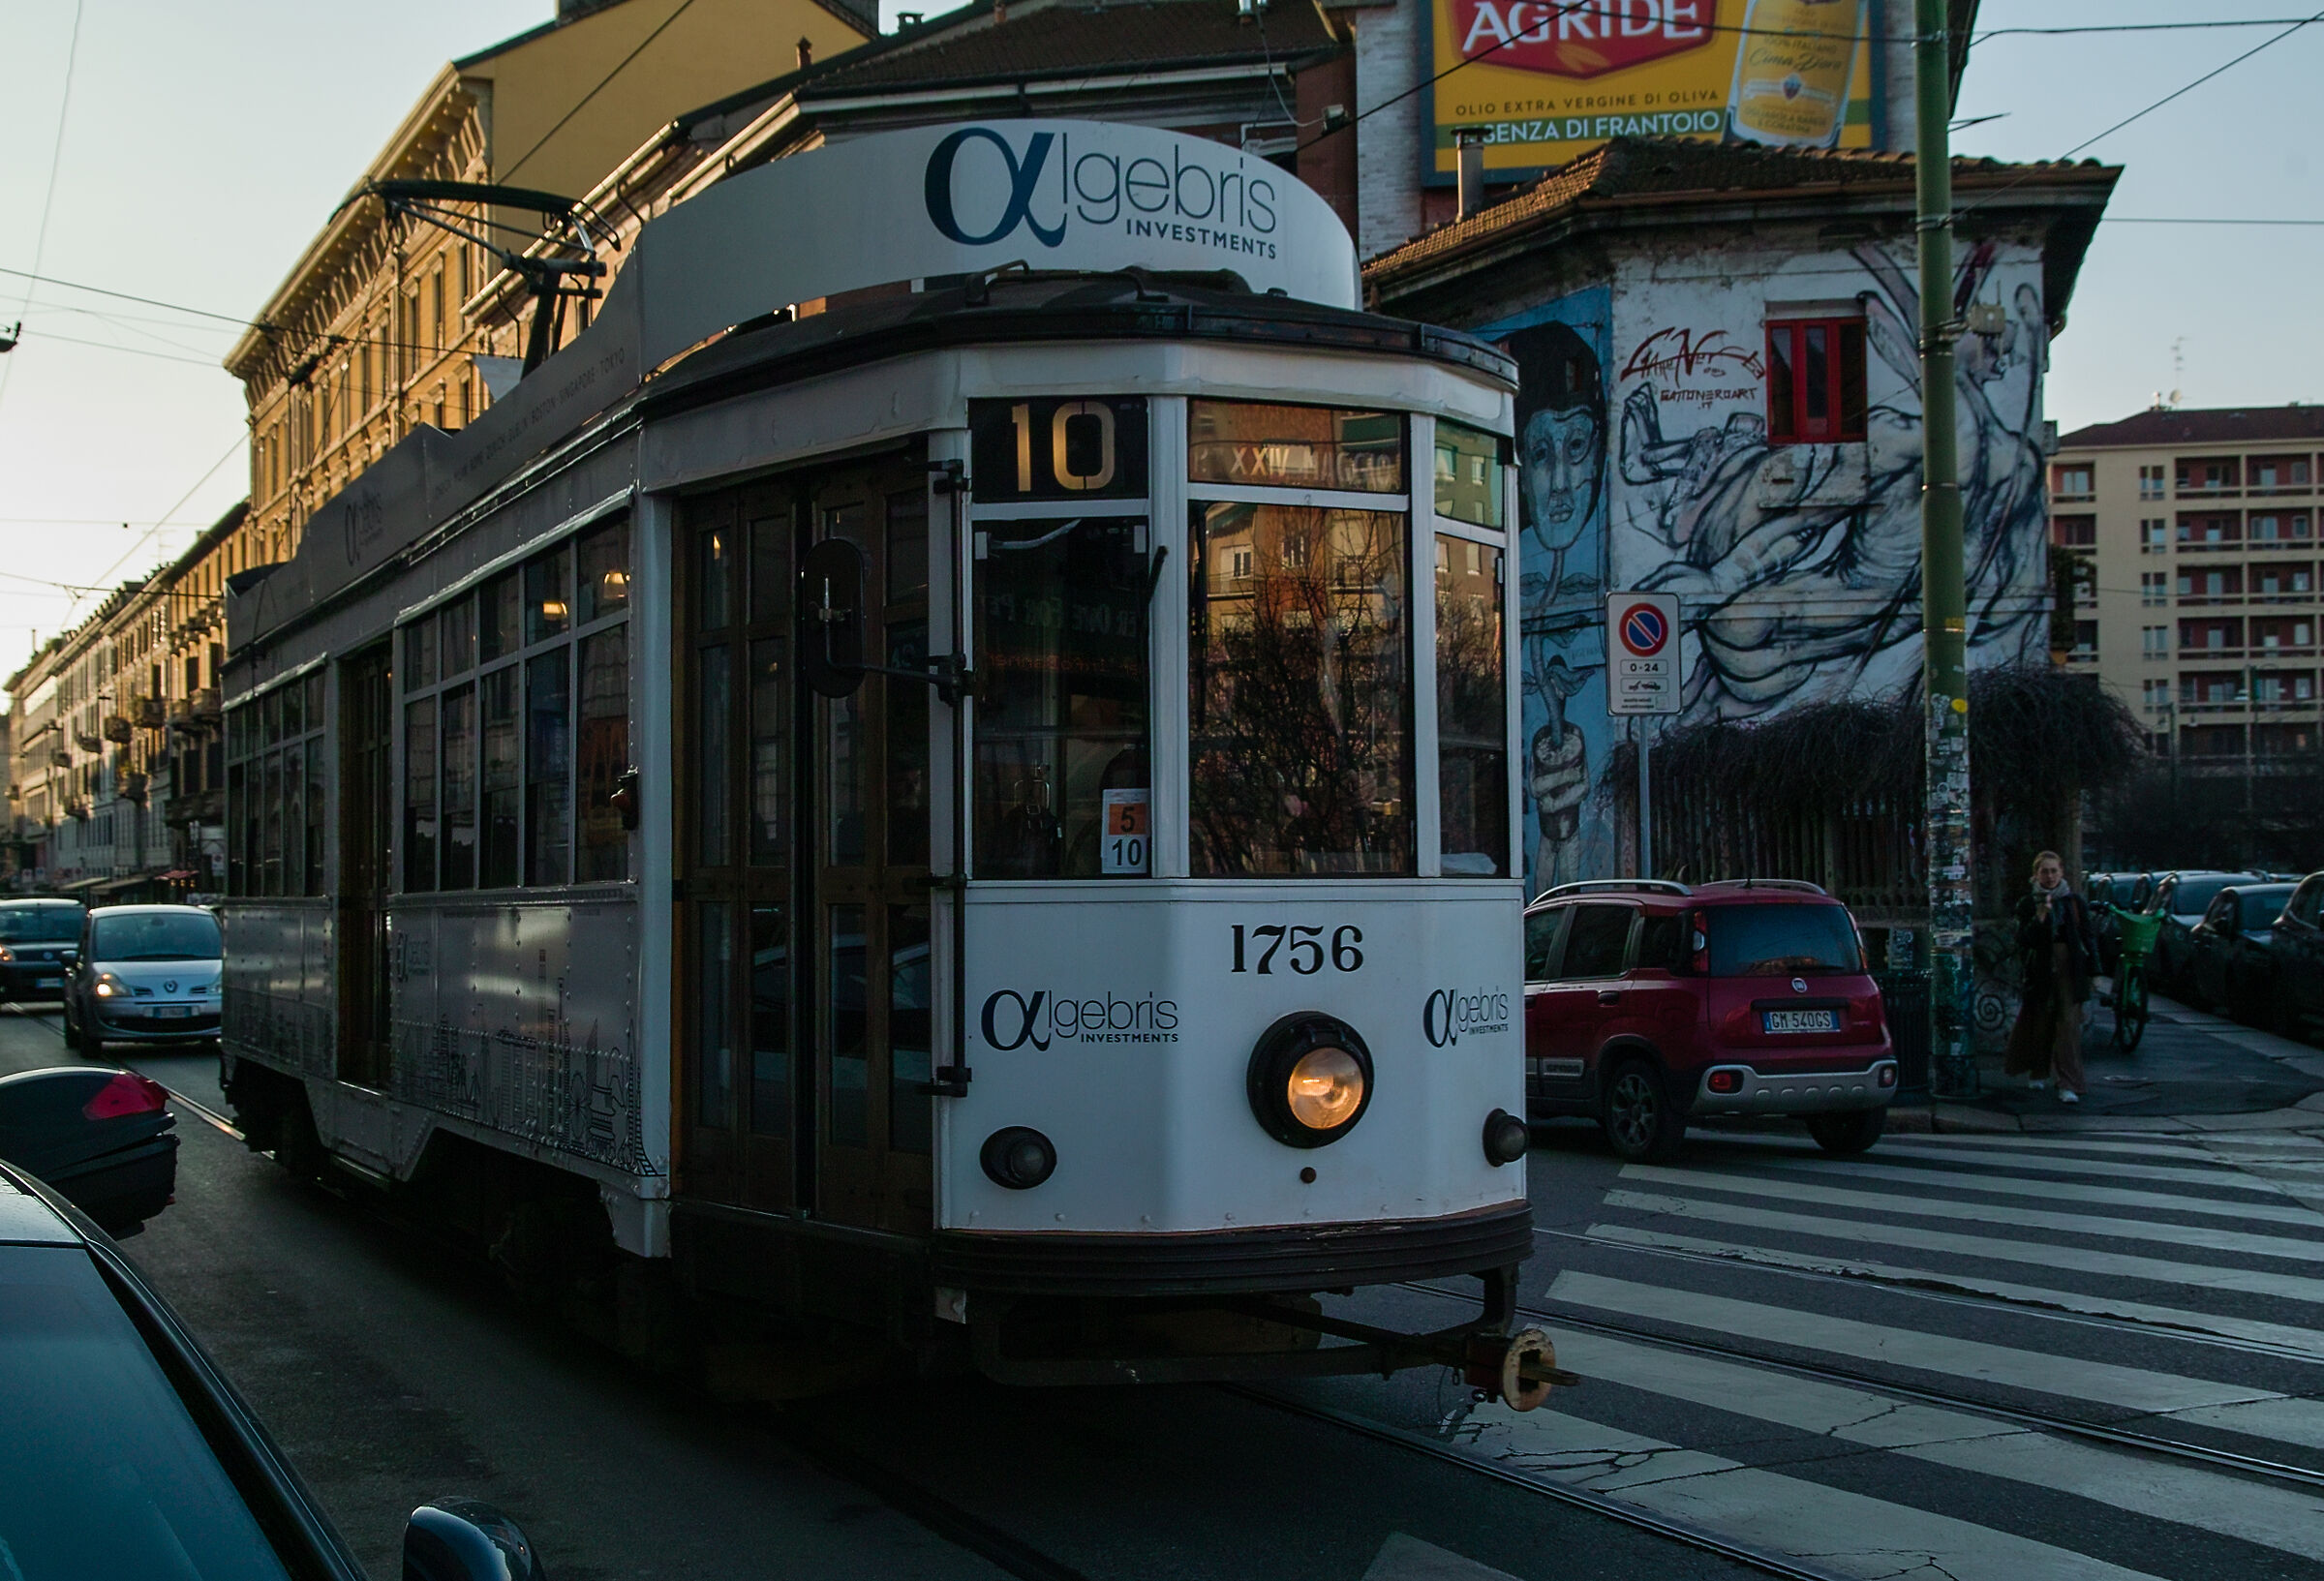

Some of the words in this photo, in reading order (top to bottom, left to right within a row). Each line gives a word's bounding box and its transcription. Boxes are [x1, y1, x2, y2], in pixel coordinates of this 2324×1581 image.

[1461, 0, 1704, 52] AGRIDE
[1455, 103, 1496, 116] OLIO
[1504, 100, 1556, 113] EXTRA
[1563, 94, 1636, 109] VERGINE
[1644, 92, 1661, 105] DI
[1668, 89, 1719, 103] OLIVA
[1456, 121, 1556, 144] SENZA
[1565, 118, 1589, 139] DI
[1595, 110, 1720, 137] FRANTOIO
[1126, 218, 1277, 259] INVESTMENTS
[599, 348, 626, 376] TOKYO
[1011, 400, 1116, 492] 10
[1230, 446, 1290, 476] XXIV
[1120, 806, 1136, 833] 5
[1112, 838, 1142, 866] 10
[1231, 925, 1364, 975] 1756
[1468, 1023, 1509, 1036] INVESTMENTS
[1772, 1013, 1789, 1028] GM
[1081, 1033, 1179, 1043] INVESTMENTS
